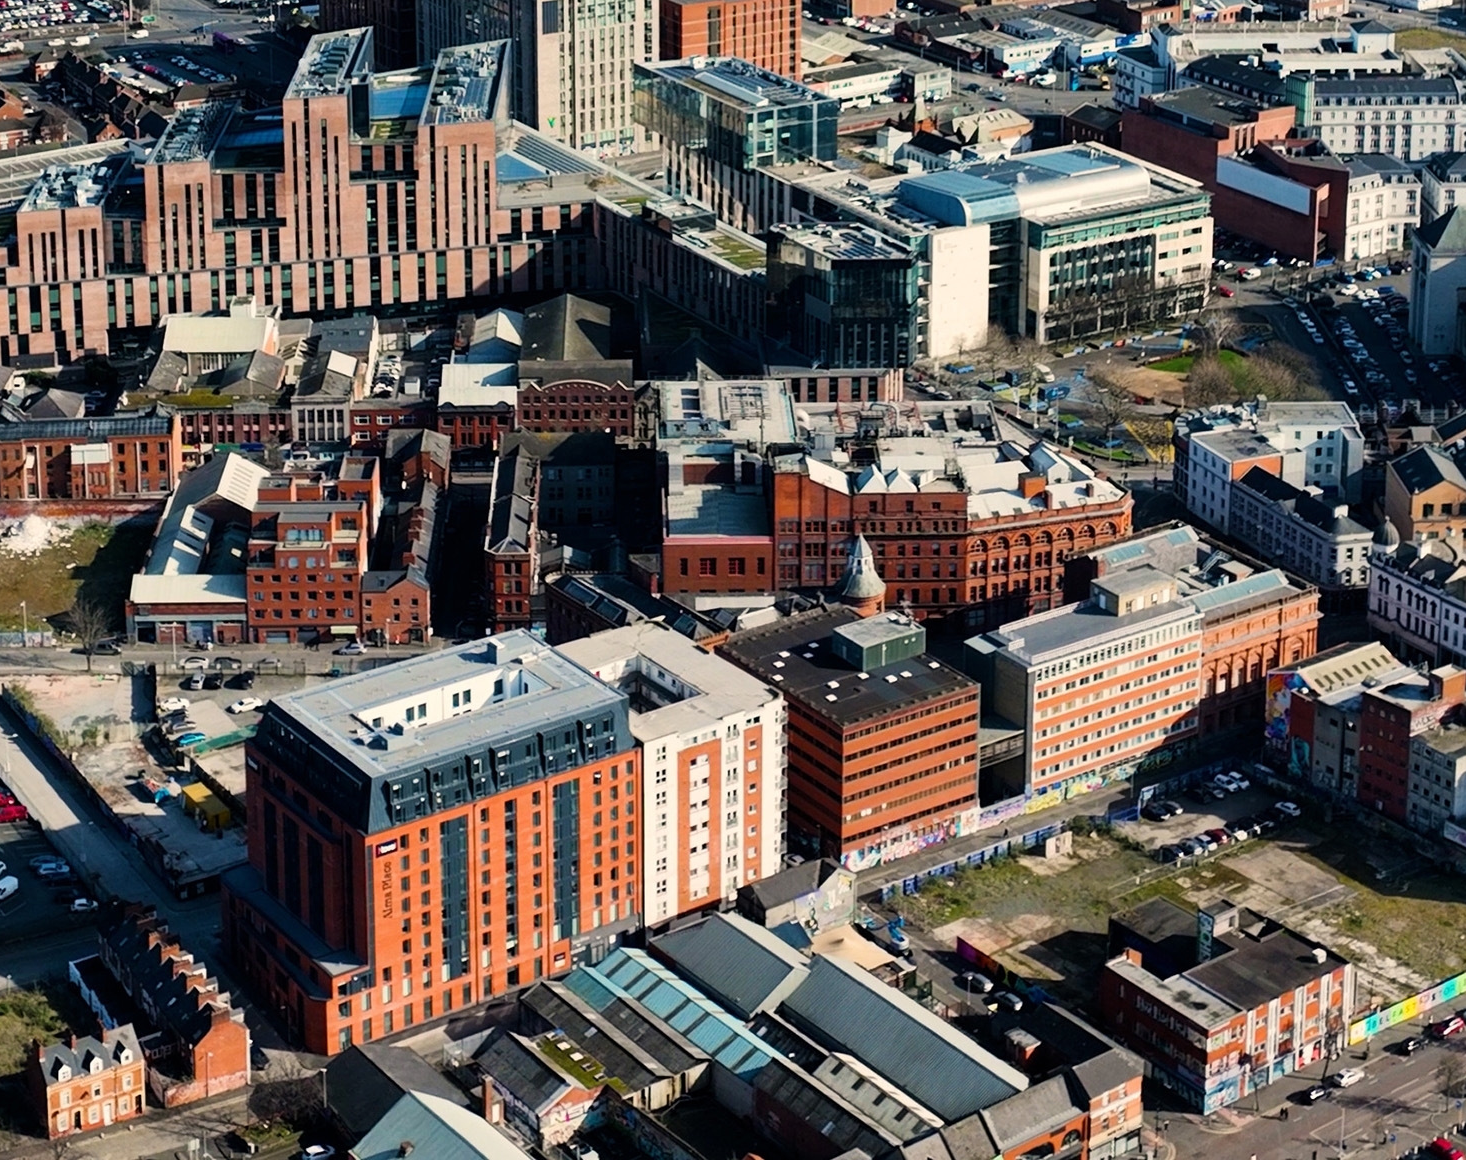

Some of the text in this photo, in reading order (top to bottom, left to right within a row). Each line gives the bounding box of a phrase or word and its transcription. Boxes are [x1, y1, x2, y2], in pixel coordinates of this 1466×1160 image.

[382, 861, 393, 890] Place
[382, 891, 393, 919] Alma
[1372, 1002, 1417, 1028] BELFAST
